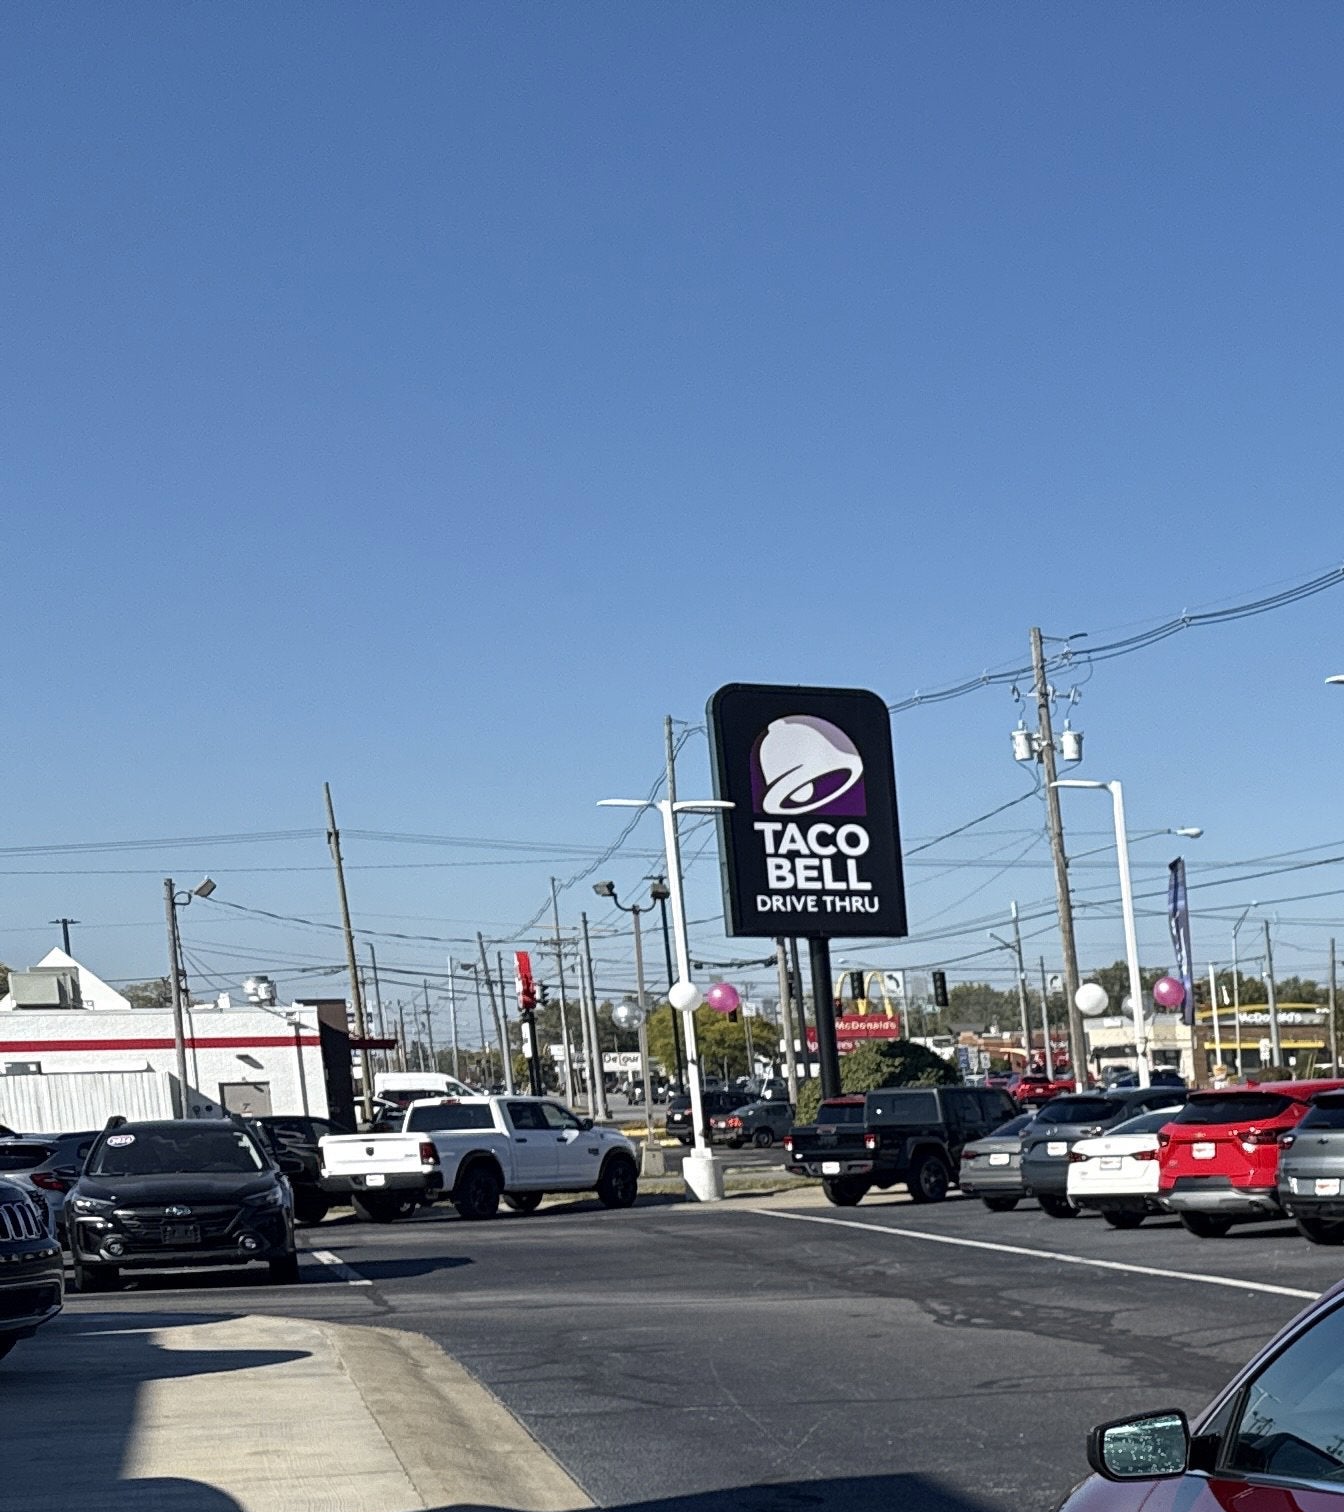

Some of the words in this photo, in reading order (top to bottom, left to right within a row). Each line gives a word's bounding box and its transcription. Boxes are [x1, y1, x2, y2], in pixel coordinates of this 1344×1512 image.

[753, 821, 870, 857] TACO
[766, 856, 873, 891] BELL
[756, 894, 819, 913] DRIVE
[821, 895, 880, 914] THRU
[835, 1020, 897, 1031] McDonald's
